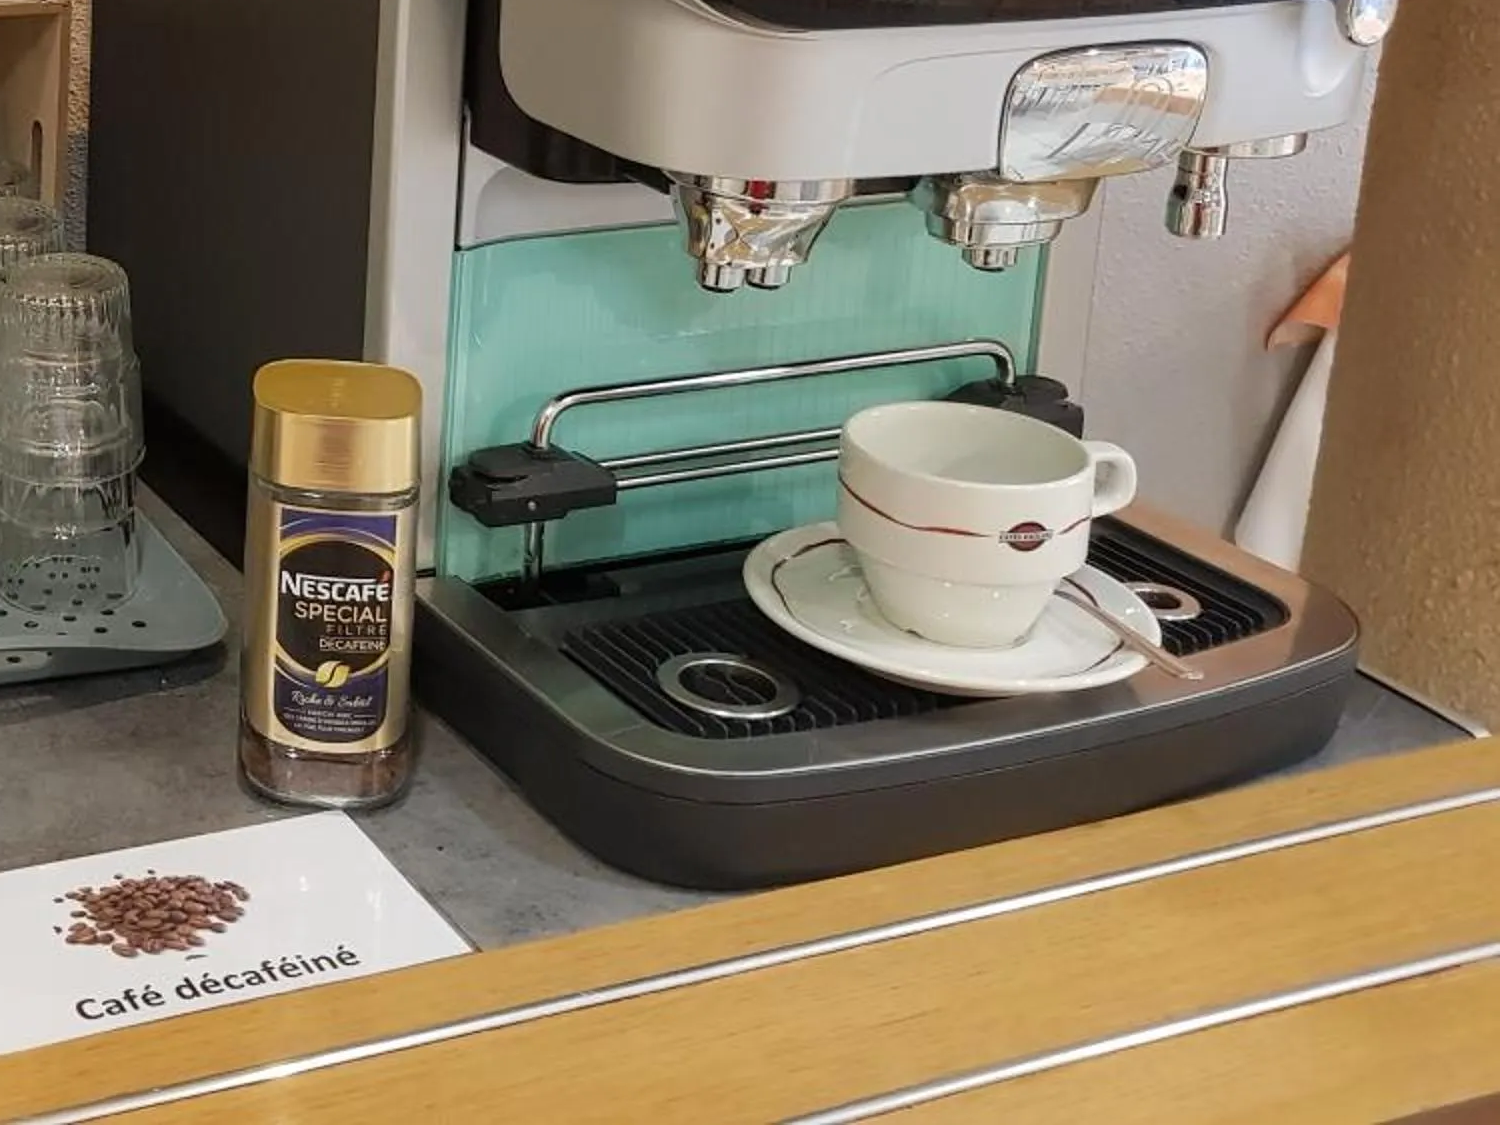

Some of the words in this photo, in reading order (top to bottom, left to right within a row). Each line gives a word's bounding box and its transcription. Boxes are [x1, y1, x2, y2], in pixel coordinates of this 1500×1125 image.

[325, 624, 387, 637] FILTRE
[76, 982, 164, 1024] Café
[176, 942, 362, 1003] décaféiné
